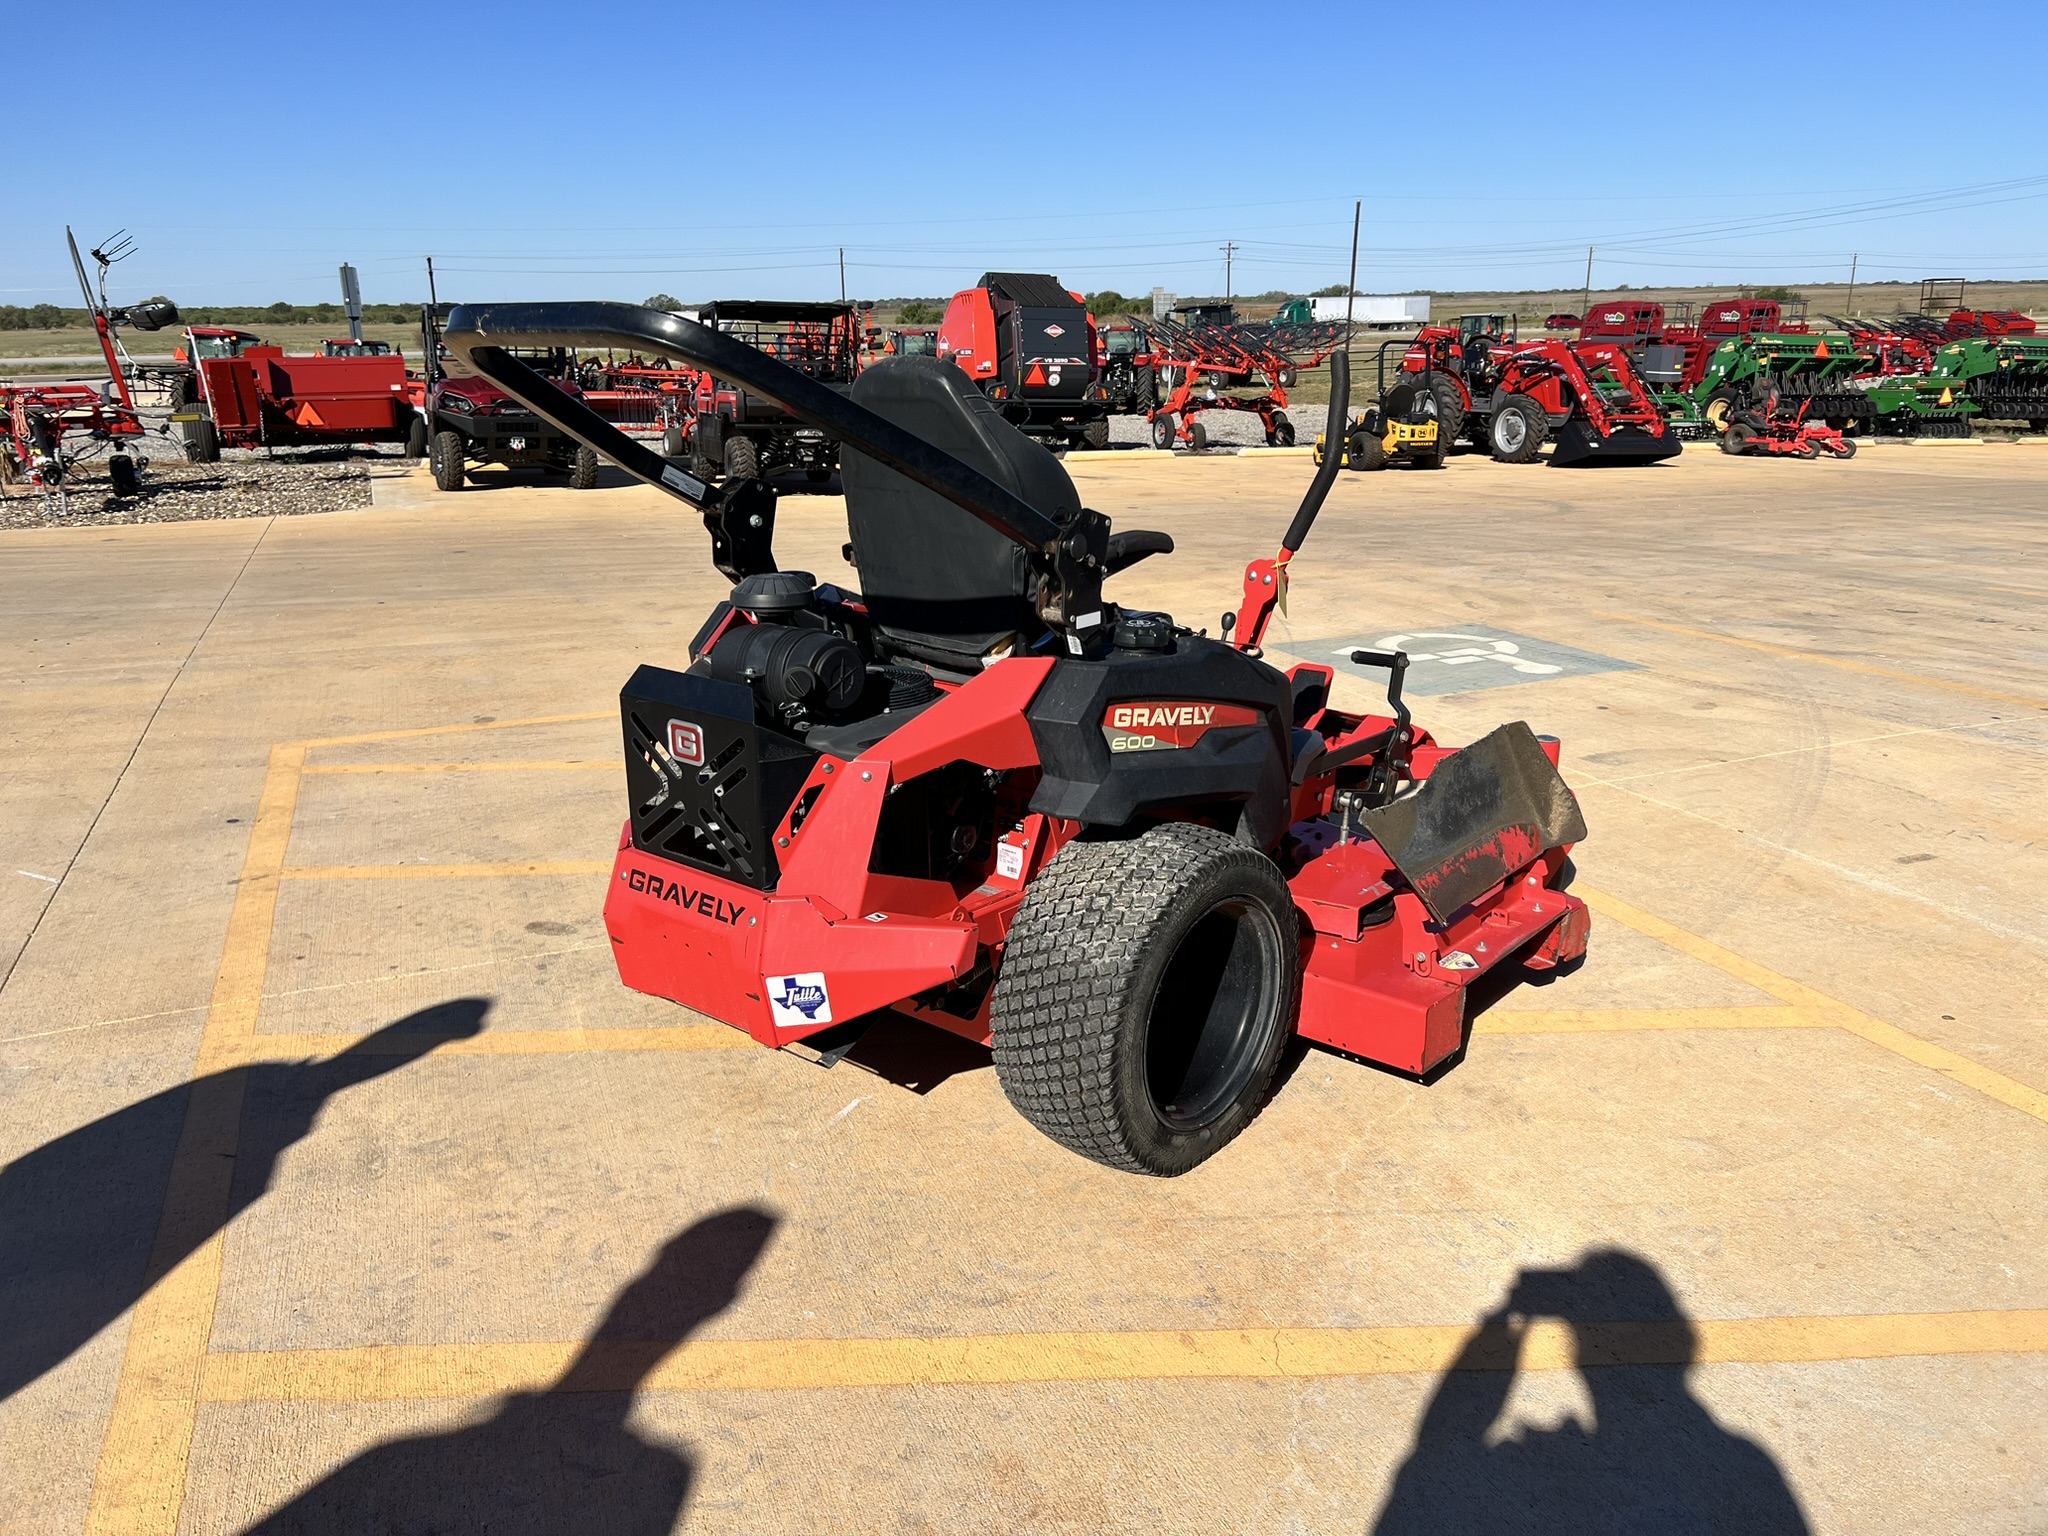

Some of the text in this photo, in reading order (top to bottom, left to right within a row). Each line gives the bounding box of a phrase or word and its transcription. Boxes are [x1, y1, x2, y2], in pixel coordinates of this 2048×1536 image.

[1113, 706, 1215, 728] GRAVELY
[1111, 735, 1156, 750] 600
[628, 868, 746, 926] GRAVELY
[786, 987, 822, 1006] Tuttle
